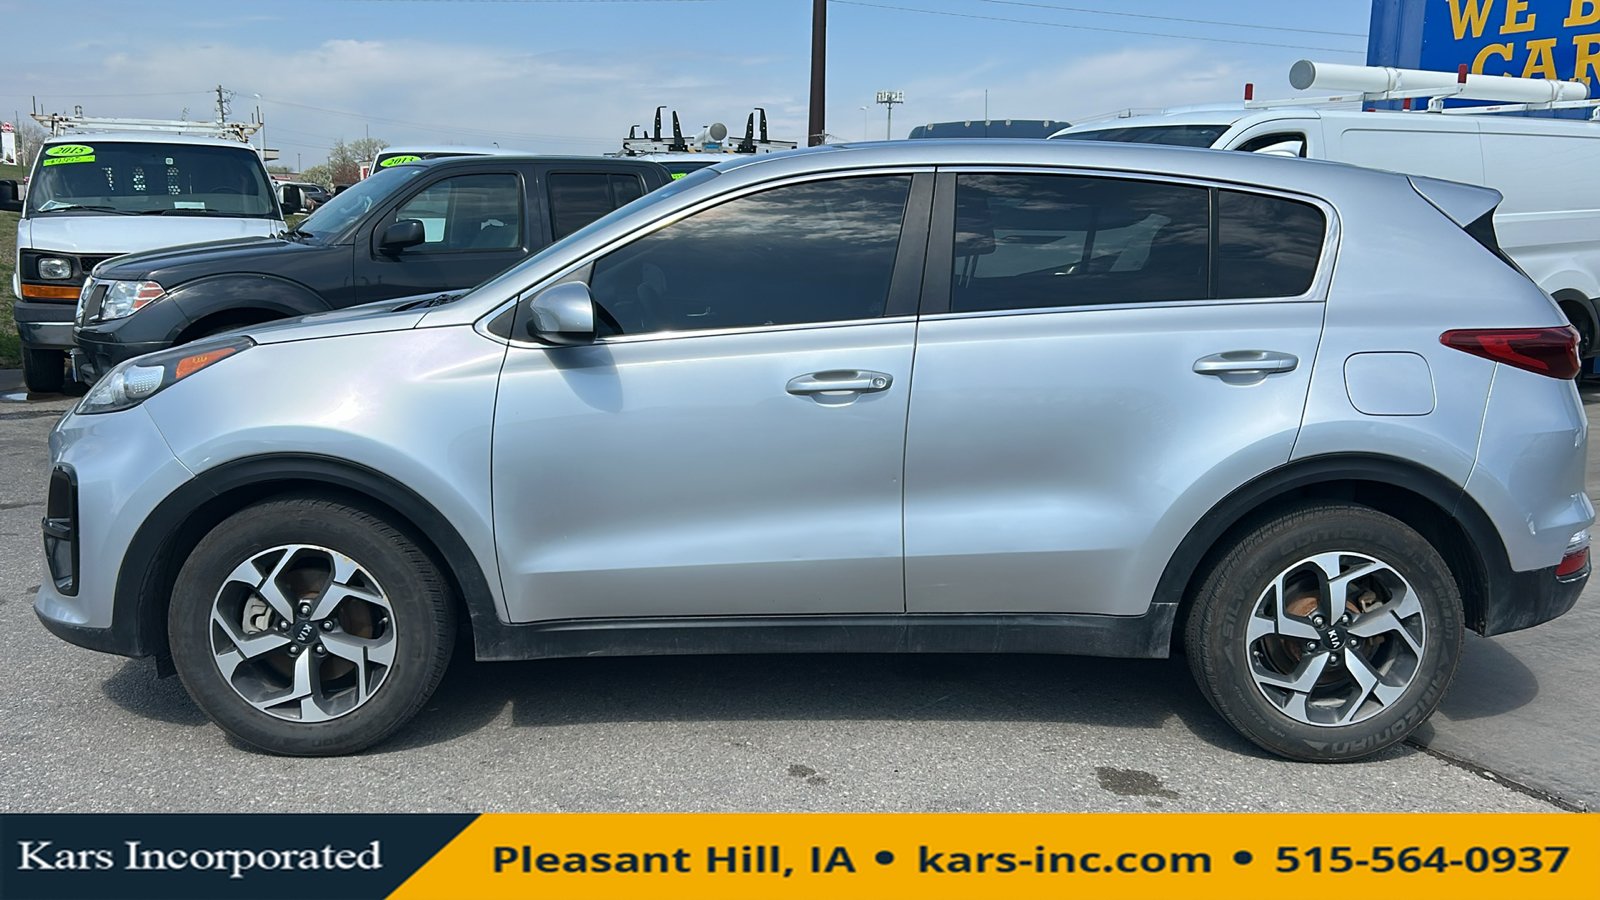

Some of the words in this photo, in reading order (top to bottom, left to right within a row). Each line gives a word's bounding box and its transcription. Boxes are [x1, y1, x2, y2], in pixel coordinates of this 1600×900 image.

[1446, 0, 1536, 41] WE
[1471, 33, 1600, 85] CAR
[53, 146, 87, 155] 2015
[387, 156, 414, 166] 2013
[297, 623, 313, 641] KIA
[1327, 629, 1341, 649] KIA
